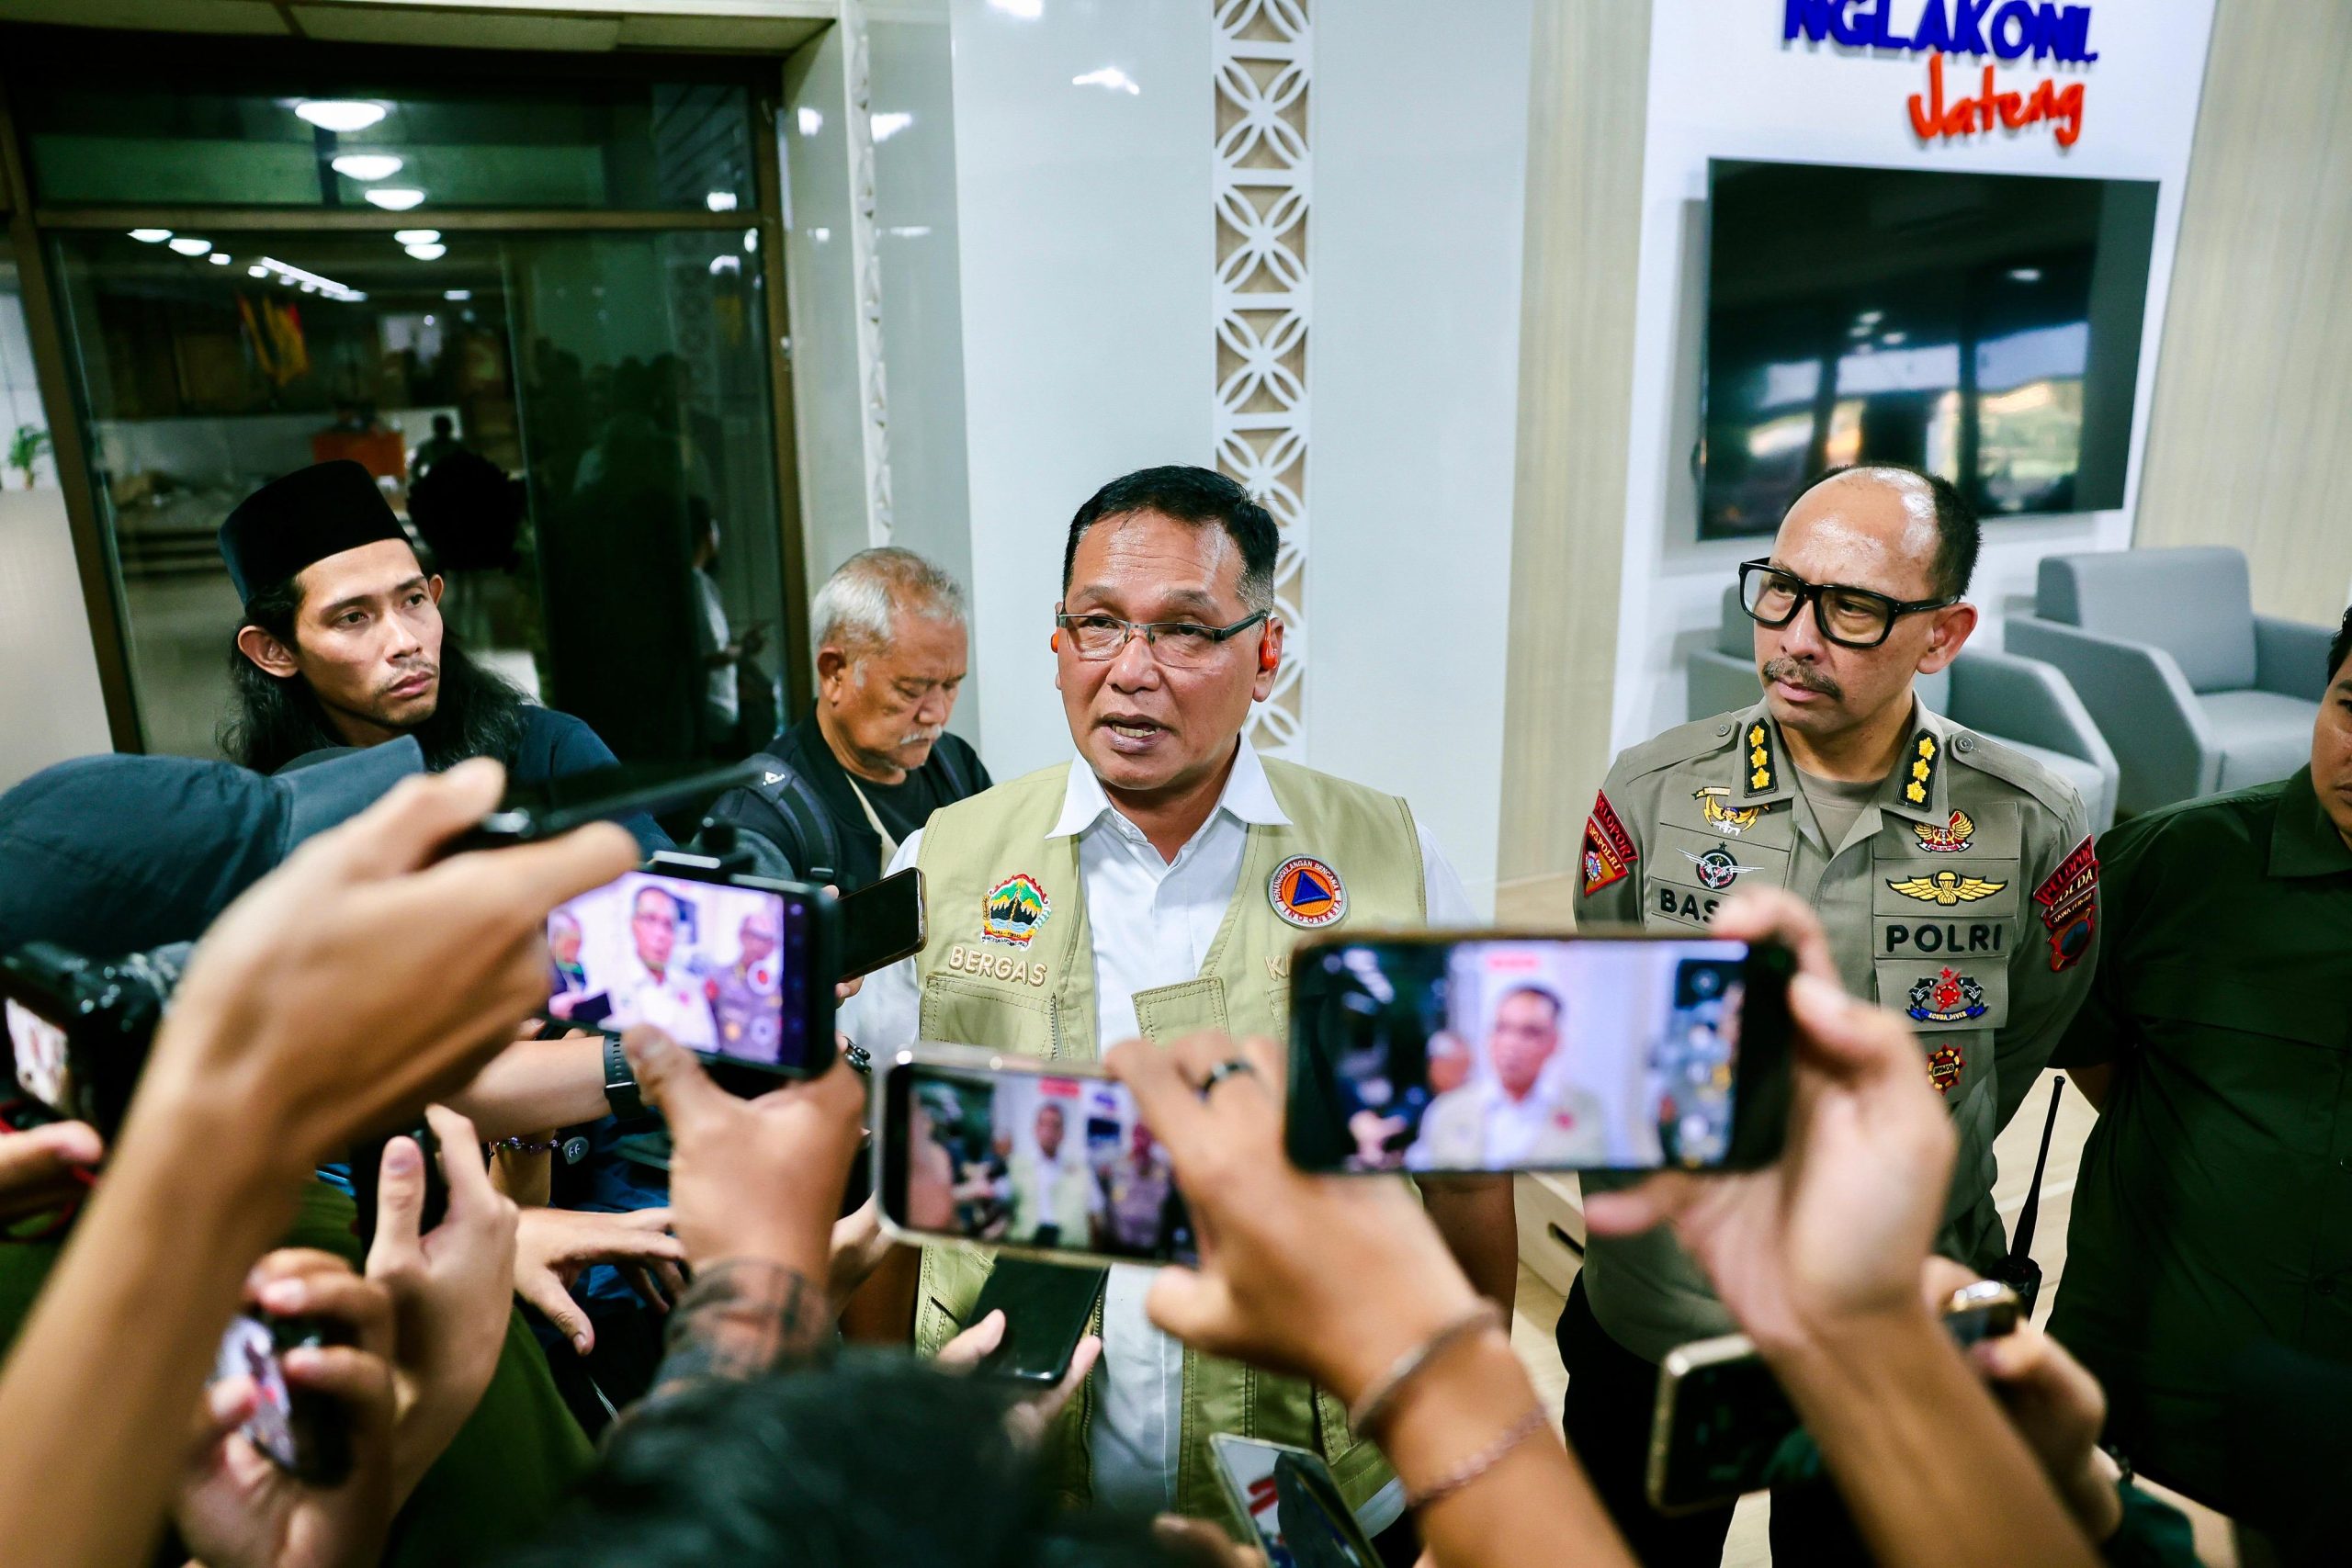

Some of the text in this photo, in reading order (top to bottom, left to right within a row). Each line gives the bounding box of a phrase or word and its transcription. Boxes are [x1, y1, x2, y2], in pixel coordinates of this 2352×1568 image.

[1908, 52, 2085, 147] Jateng
[1283, 900, 1341, 924] INDONESIA
[1886, 924, 2002, 953] POLRI
[949, 945, 1048, 987] BERGAS
